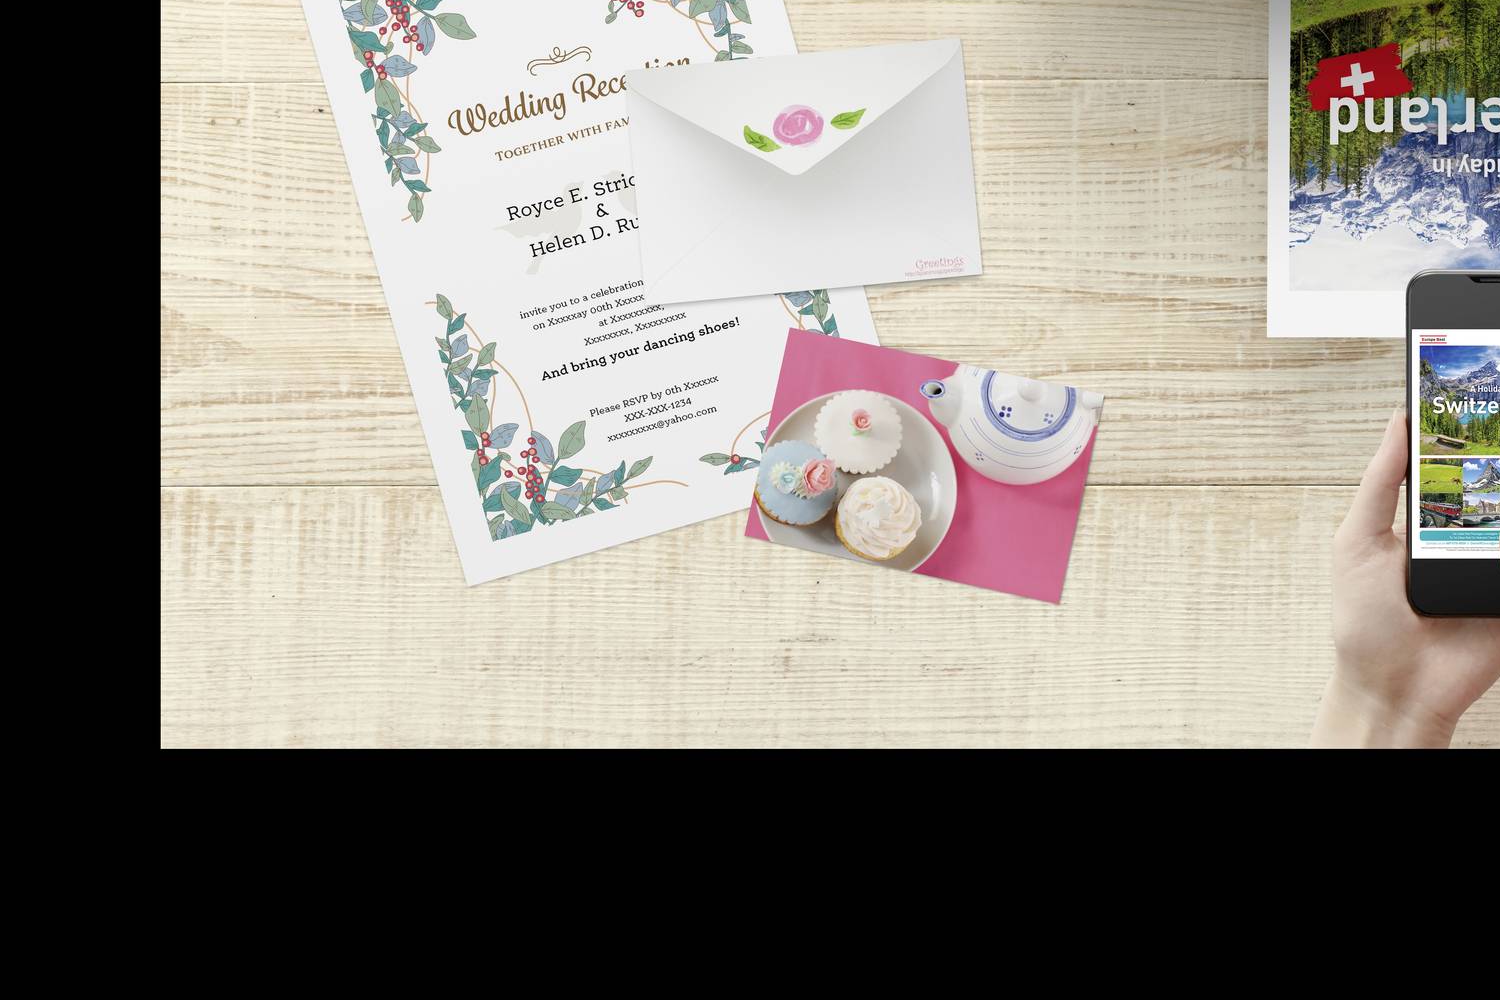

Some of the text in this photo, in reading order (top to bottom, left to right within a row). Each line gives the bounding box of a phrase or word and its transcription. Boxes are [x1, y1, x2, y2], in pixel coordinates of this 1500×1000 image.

[448, 91, 567, 137] Wedding
[1433, 158, 1453, 177] In
[506, 196, 565, 222] Royce
[569, 188, 588, 204] E.
[596, 203, 609, 218] &
[529, 233, 587, 259] Helen
[589, 225, 611, 241] D.
[519, 278, 644, 319] invite you to a celebration
[532, 321, 546, 331] on
[598, 317, 609, 327] at
[541, 316, 741, 381] And bring your dancing shoes!
[589, 402, 621, 417] Please
[622, 393, 649, 408] RSVP
[650, 390, 663, 403] by
[624, 397, 692, 423] XXX-XXX-1234
